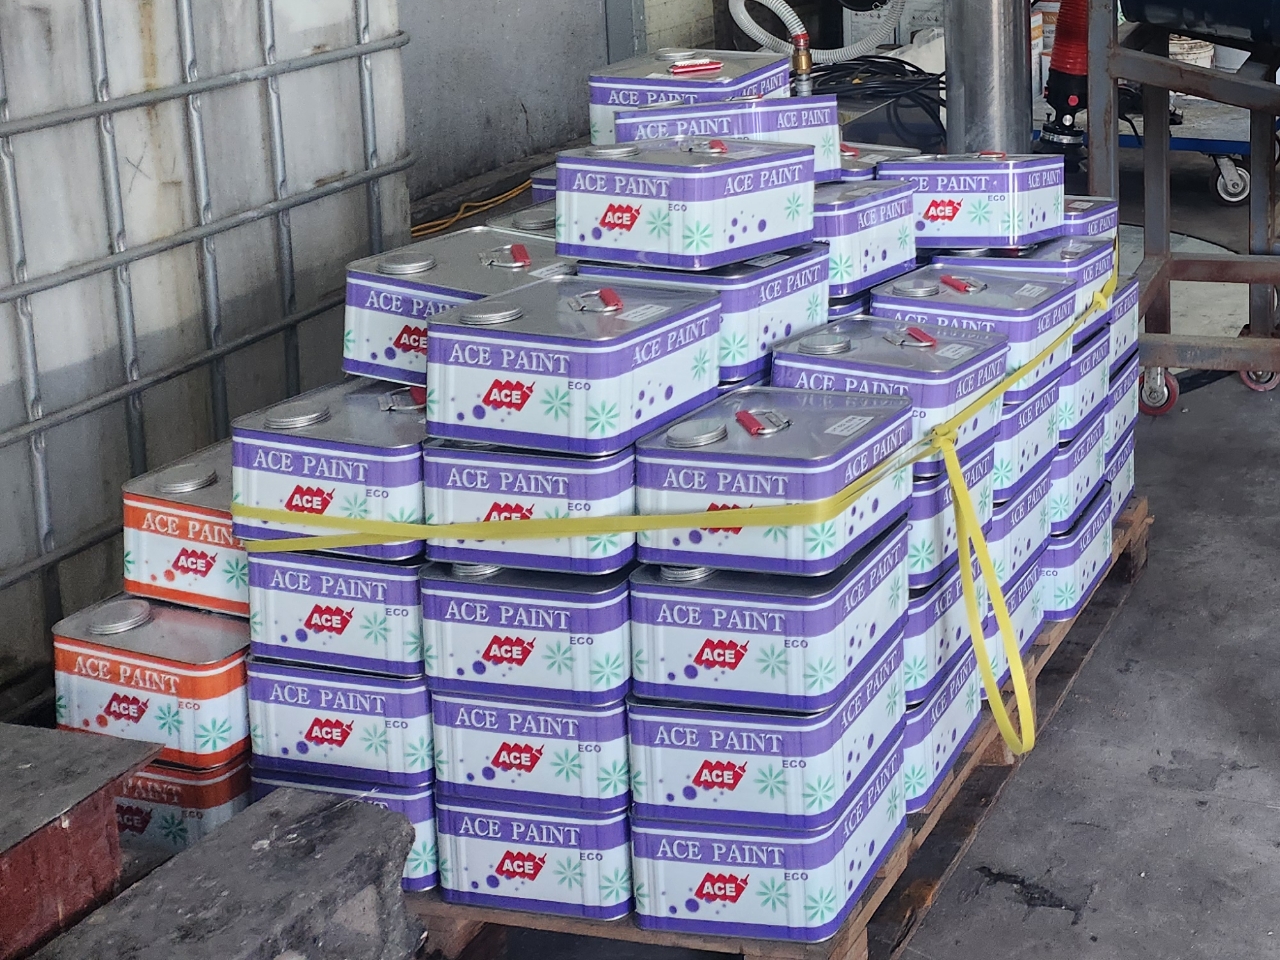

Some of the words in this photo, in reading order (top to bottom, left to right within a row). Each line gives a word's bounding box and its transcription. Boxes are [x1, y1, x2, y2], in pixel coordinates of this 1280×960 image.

[760, 72, 784, 95] PAINT
[608, 90, 640, 105] ACE
[635, 124, 667, 141] ACE
[677, 118, 731, 136] PAINT
[777, 111, 798, 128] ACE
[802, 109, 830, 126] PAINT
[572, 171, 608, 193] ACE
[615, 177, 670, 198] PAINT
[724, 174, 753, 195] ACE
[759, 165, 803, 188] PAINT
[901, 176, 929, 191] CE
[937, 176, 989, 191] PAINT
[1028, 173, 1040, 188] ACE
[1042, 169, 1061, 185] PAINT
[605, 211, 631, 225] ACE
[668, 204, 687, 212] ECO
[858, 211, 876, 229] ACE
[879, 198, 907, 221] PAINT
[928, 206, 953, 216] ACE
[1088, 223, 1098, 235] ACE
[1099, 214, 1115, 232] PAINT
[1082, 268, 1093, 283] ACE
[1095, 255, 1111, 276] PAINT
[759, 282, 782, 304] ACE
[786, 264, 821, 293] PAINT
[365, 291, 403, 313] ACE
[412, 298, 459, 317] PAI
[1037, 318, 1050, 333] ACE
[1053, 300, 1073, 325] PAINT
[400, 334, 427, 346] ACE
[632, 341, 661, 368] ACE
[667, 317, 710, 351] PAINT
[449, 343, 492, 366] ACE
[501, 348, 570, 374] PAINT
[568, 381, 591, 391] ECO
[795, 371, 835, 391] ACE
[846, 378, 909, 397] PAINT
[955, 379, 974, 398] ACE
[977, 358, 1003, 386] PAINT
[490, 389, 522, 403] ACE
[912, 410, 926, 418] CO
[1018, 406, 1033, 431] ACE
[1035, 388, 1055, 417] PAINT
[844, 456, 869, 483] ACE
[872, 426, 906, 464] PAINT
[1073, 444, 1085, 466] ACE
[1086, 423, 1102, 451] PAINT
[253, 449, 294, 472] ACE
[302, 455, 369, 482] PAINT
[447, 468, 490, 489] ACE
[500, 472, 569, 495] PAINT
[663, 469, 707, 488] ACE
[717, 473, 789, 495] PAINT
[291, 496, 322, 509] ACE
[366, 489, 389, 498] ECO
[1010, 504, 1025, 526] ACE
[1027, 478, 1048, 512] PAINT
[568, 502, 591, 511] ECO
[142, 513, 180, 535] ACE
[188, 520, 245, 547] PAIN
[1079, 530, 1091, 552] ACE
[1092, 503, 1110, 539] PAINT
[178, 556, 206, 571] ACE
[270, 569, 311, 592] ACE
[320, 575, 387, 601] PAINT
[843, 584, 865, 616] ACE
[870, 544, 901, 582] PAINT
[1007, 594, 1017, 611] CE
[1019, 565, 1039, 599] PAINT
[385, 608, 409, 617] ECO
[445, 600, 489, 623] ACE
[499, 605, 571, 630] PAINT
[934, 591, 953, 620] ACE
[310, 614, 342, 627] ACE
[657, 603, 702, 625] ACE
[712, 608, 785, 632] PAINT
[489, 646, 523, 658] ACE
[570, 636, 594, 645] ECO
[784, 639, 808, 649] ECO
[701, 649, 735, 663] ACE
[73, 656, 111, 679] ACE
[119, 665, 179, 693] PAINT
[270, 684, 311, 704] ACE
[320, 690, 386, 713] PAINT
[841, 696, 862, 732] ACE
[866, 652, 898, 701] PAINT
[930, 692, 947, 725] ACE
[950, 653, 974, 696] PAINT
[110, 700, 138, 717] ACE
[178, 701, 200, 710] ECO
[311, 726, 342, 740] ACE
[385, 721, 408, 729] ECO
[455, 708, 498, 730] ACE
[508, 713, 579, 737] PAINT
[578, 744, 601, 753] ECO
[654, 725, 700, 748] ACE
[710, 730, 783, 754] PAINT
[499, 751, 531, 766] ACE
[782, 759, 807, 769] ECO
[700, 769, 734, 784] ACE
[843, 802, 864, 842] ACE
[868, 753, 898, 801] PAINT
[459, 816, 502, 838] ACE
[511, 821, 580, 846] PAINT
[580, 852, 603, 861] ECO
[656, 839, 702, 860] ACE
[712, 843, 785, 866] PAINT
[502, 860, 534, 874] ACE
[784, 872, 808, 881] ECO
[702, 882, 736, 896] ACE
